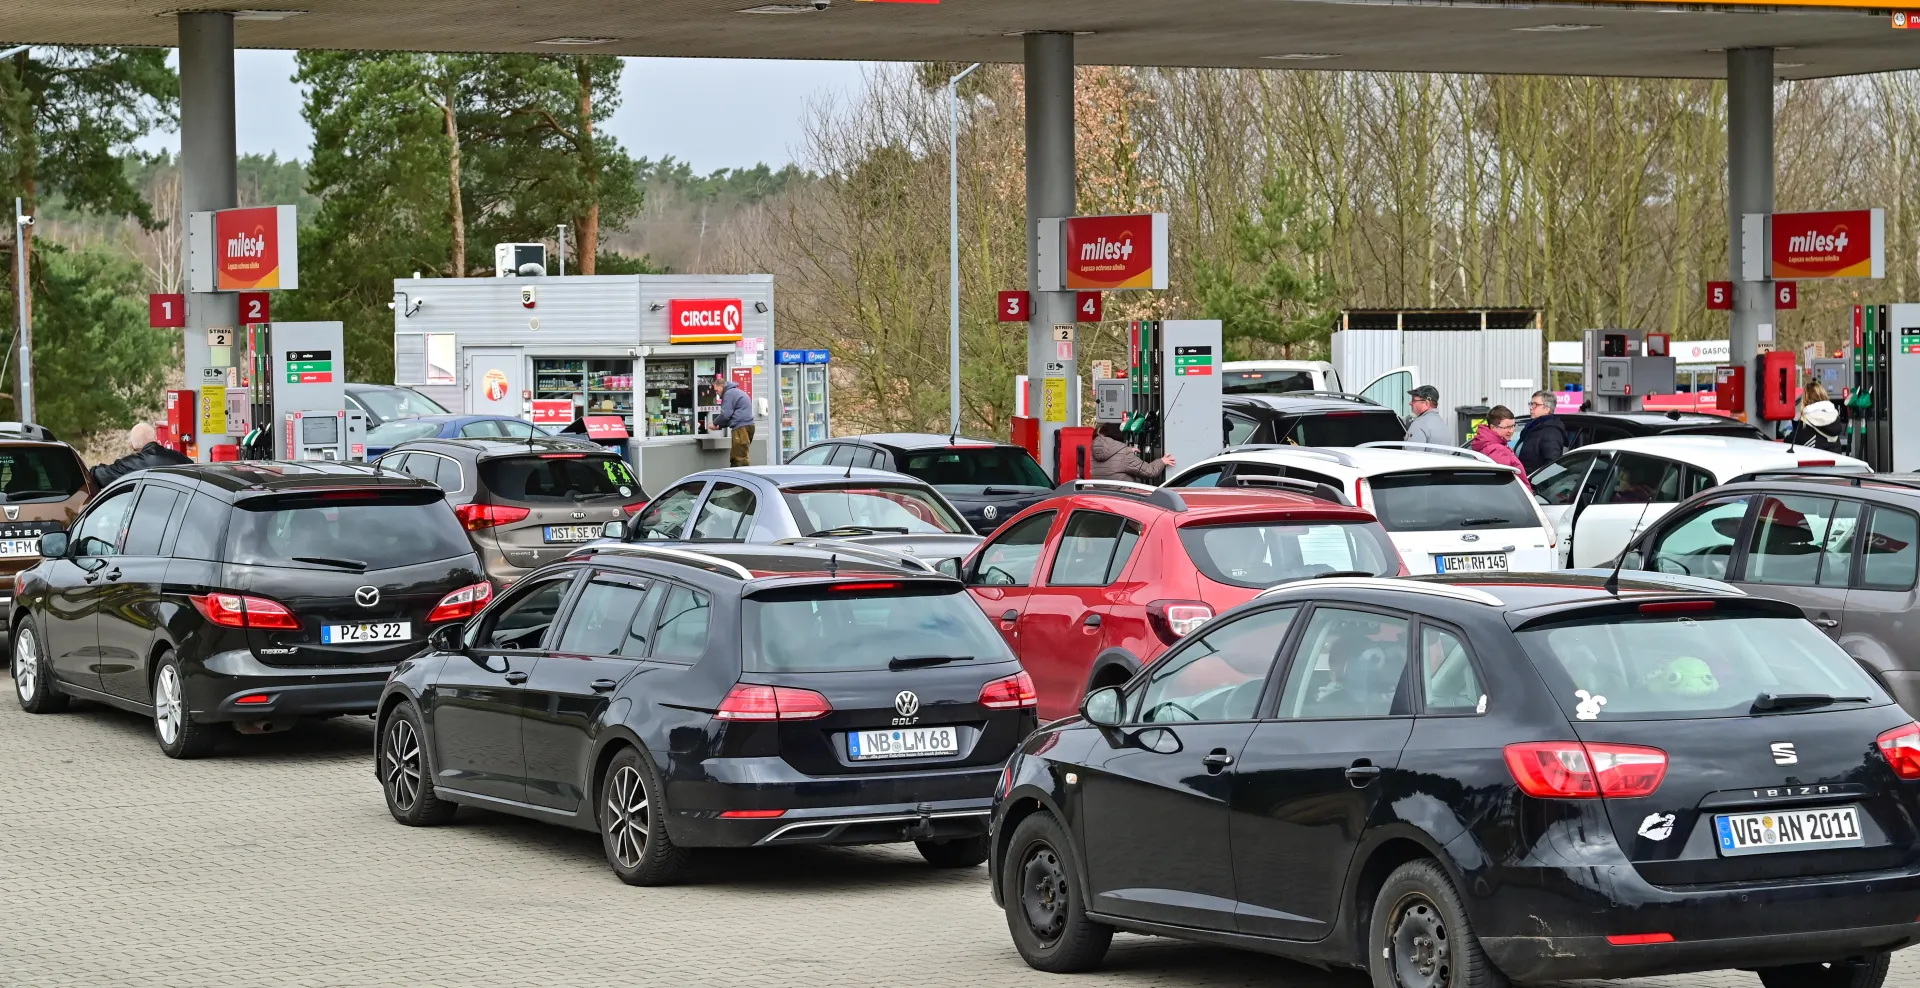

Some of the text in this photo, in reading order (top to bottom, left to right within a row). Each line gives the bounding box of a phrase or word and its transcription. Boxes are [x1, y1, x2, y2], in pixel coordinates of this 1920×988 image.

[228, 232, 264, 258] miles+
[1081, 237, 1133, 260] miles+
[1789, 231, 1848, 252] miles+
[1714, 288, 1723, 303] 5
[1780, 288, 1790, 303] 6
[162, 302, 172, 320] 1
[248, 300, 261, 318] 2
[1007, 298, 1019, 314] 3
[1083, 298, 1095, 314] 4
[681, 310, 720, 326] CIRCLE
[217, 335, 224, 344] 2
[1062, 331, 1068, 339] 2
[552, 527, 569, 539] MST
[577, 526, 588, 538] SE
[1444, 556, 1505, 571] UEM RH 145
[341, 625, 359, 640] PZ
[370, 624, 378, 638] S
[384, 624, 401, 638] 22
[892, 717, 919, 725] GOLF
[867, 733, 890, 752] NB
[902, 732, 926, 751] LM
[929, 730, 950, 749] 68
[1753, 786, 1829, 798] IBIZA
[1732, 818, 1762, 845] VG
[1778, 815, 1804, 842] AN
[1806, 812, 1858, 840] 2011
